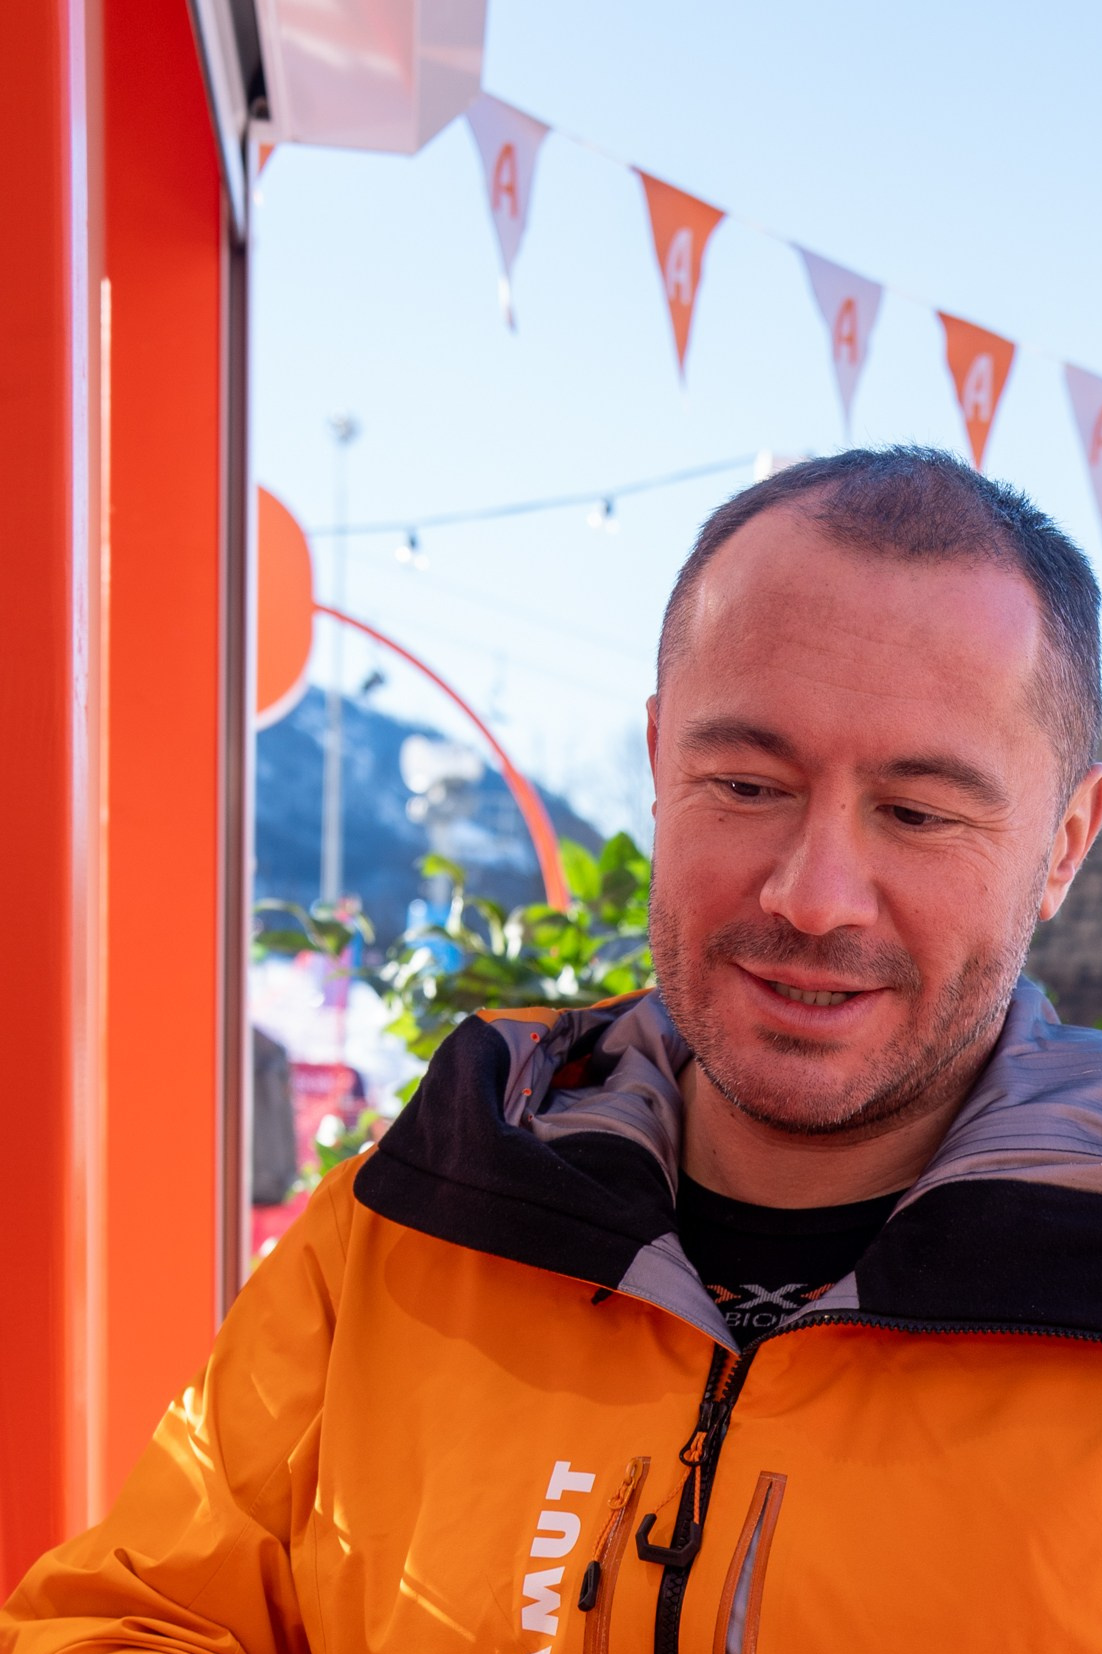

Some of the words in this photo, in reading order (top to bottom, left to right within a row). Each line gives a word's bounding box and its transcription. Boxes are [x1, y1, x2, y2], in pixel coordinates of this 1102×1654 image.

[492, 142, 519, 220] A
[667, 227, 694, 306] A
[832, 297, 859, 366] A
[962, 353, 994, 422] A
